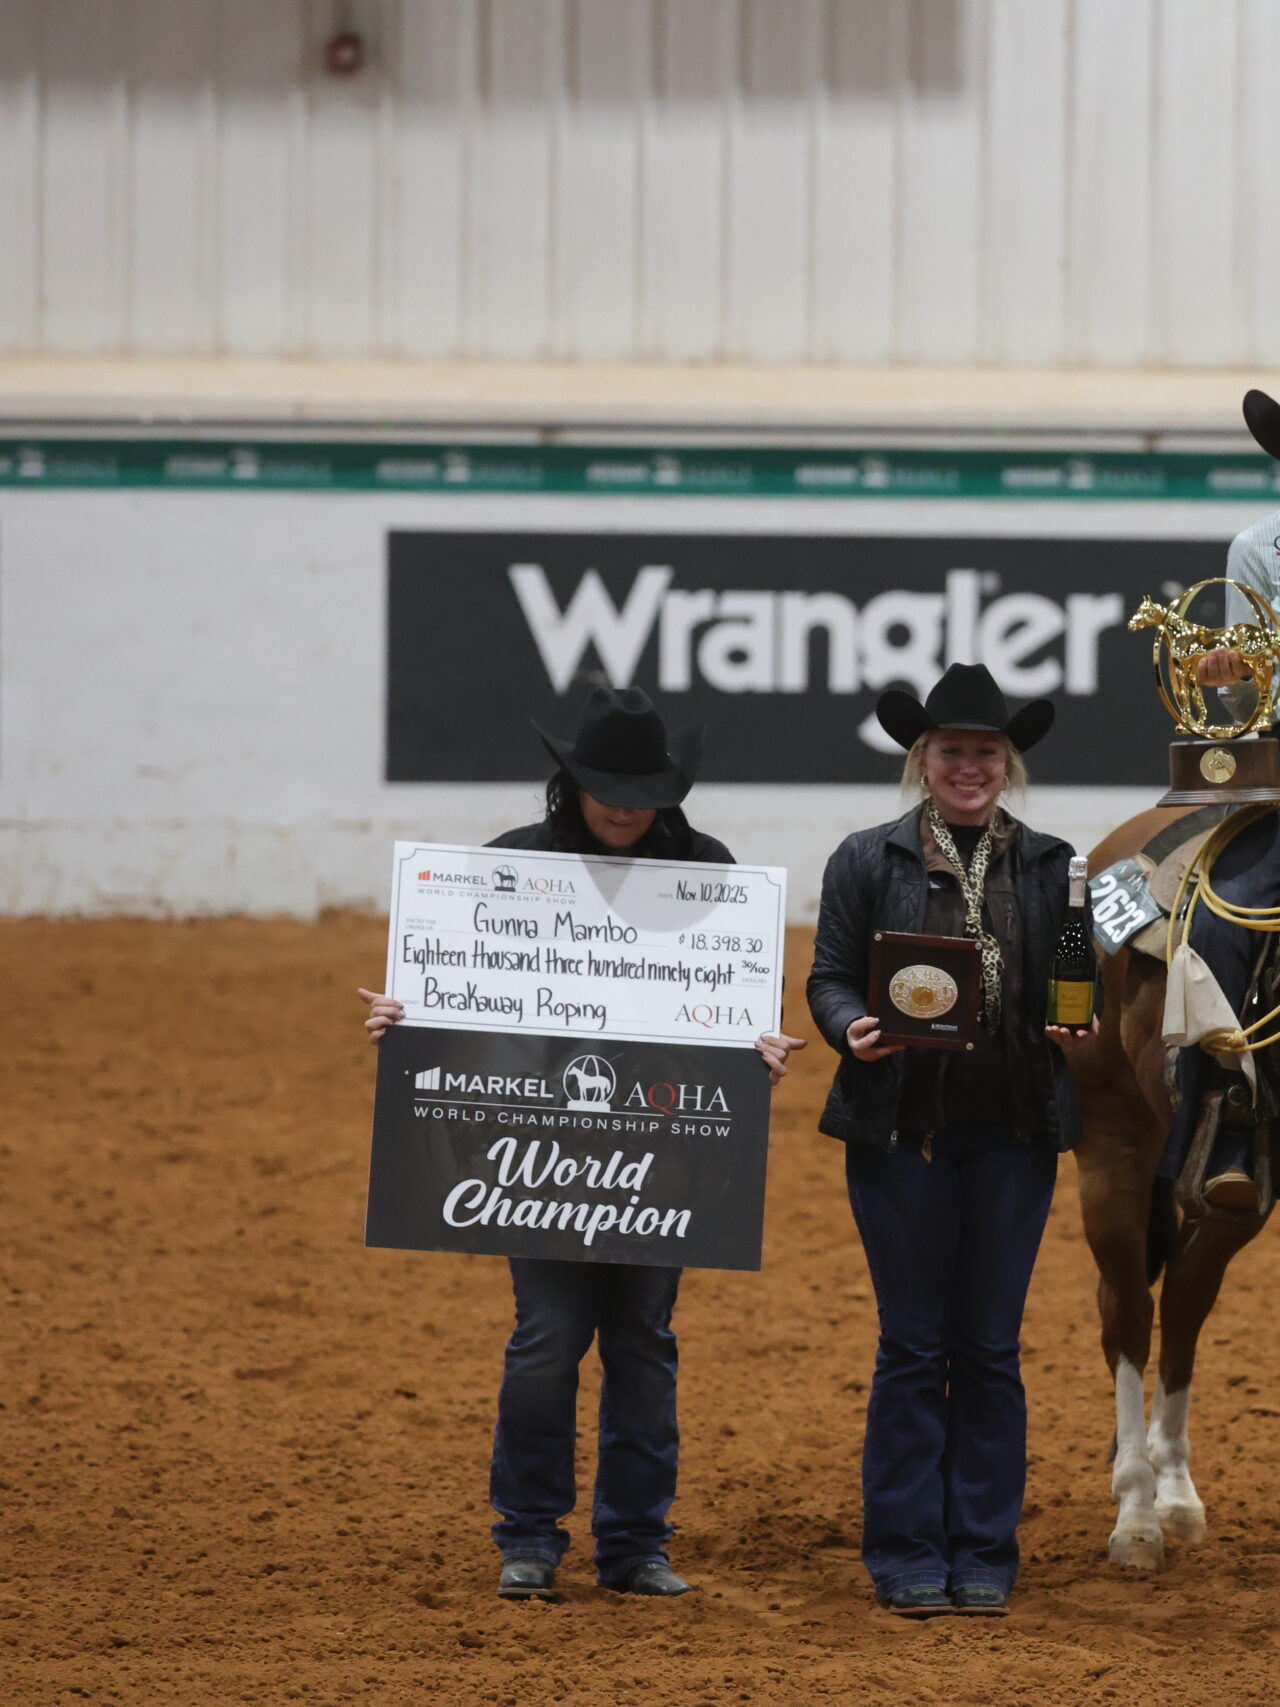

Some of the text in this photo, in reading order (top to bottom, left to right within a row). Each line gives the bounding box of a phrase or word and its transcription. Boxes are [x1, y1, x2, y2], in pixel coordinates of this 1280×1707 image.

[507, 564, 1123, 755] Wrangler
[417, 888, 454, 897] WORLD
[459, 891, 541, 902] CHAMPIONSHIP
[433, 872, 576, 895] MARKEL AQHA
[474, 902, 638, 944] Gunna Mambo
[1091, 874, 1146, 943] 2623
[403, 934, 466, 975] Eighteen
[472, 940, 540, 973] thousand
[545, 948, 583, 976] three
[588, 950, 645, 980] hundred
[648, 960, 690, 992] ninety
[695, 963, 735, 992] eight
[537, 987, 606, 1030] Roping
[674, 1004, 754, 1028] AQHA
[445, 1073, 731, 1115] MARKEL AQHA
[414, 1106, 730, 1137] WORLD CHAMPIONSHIP SHOW
[487, 1137, 654, 1191] World
[442, 1178, 692, 1246] Champion
